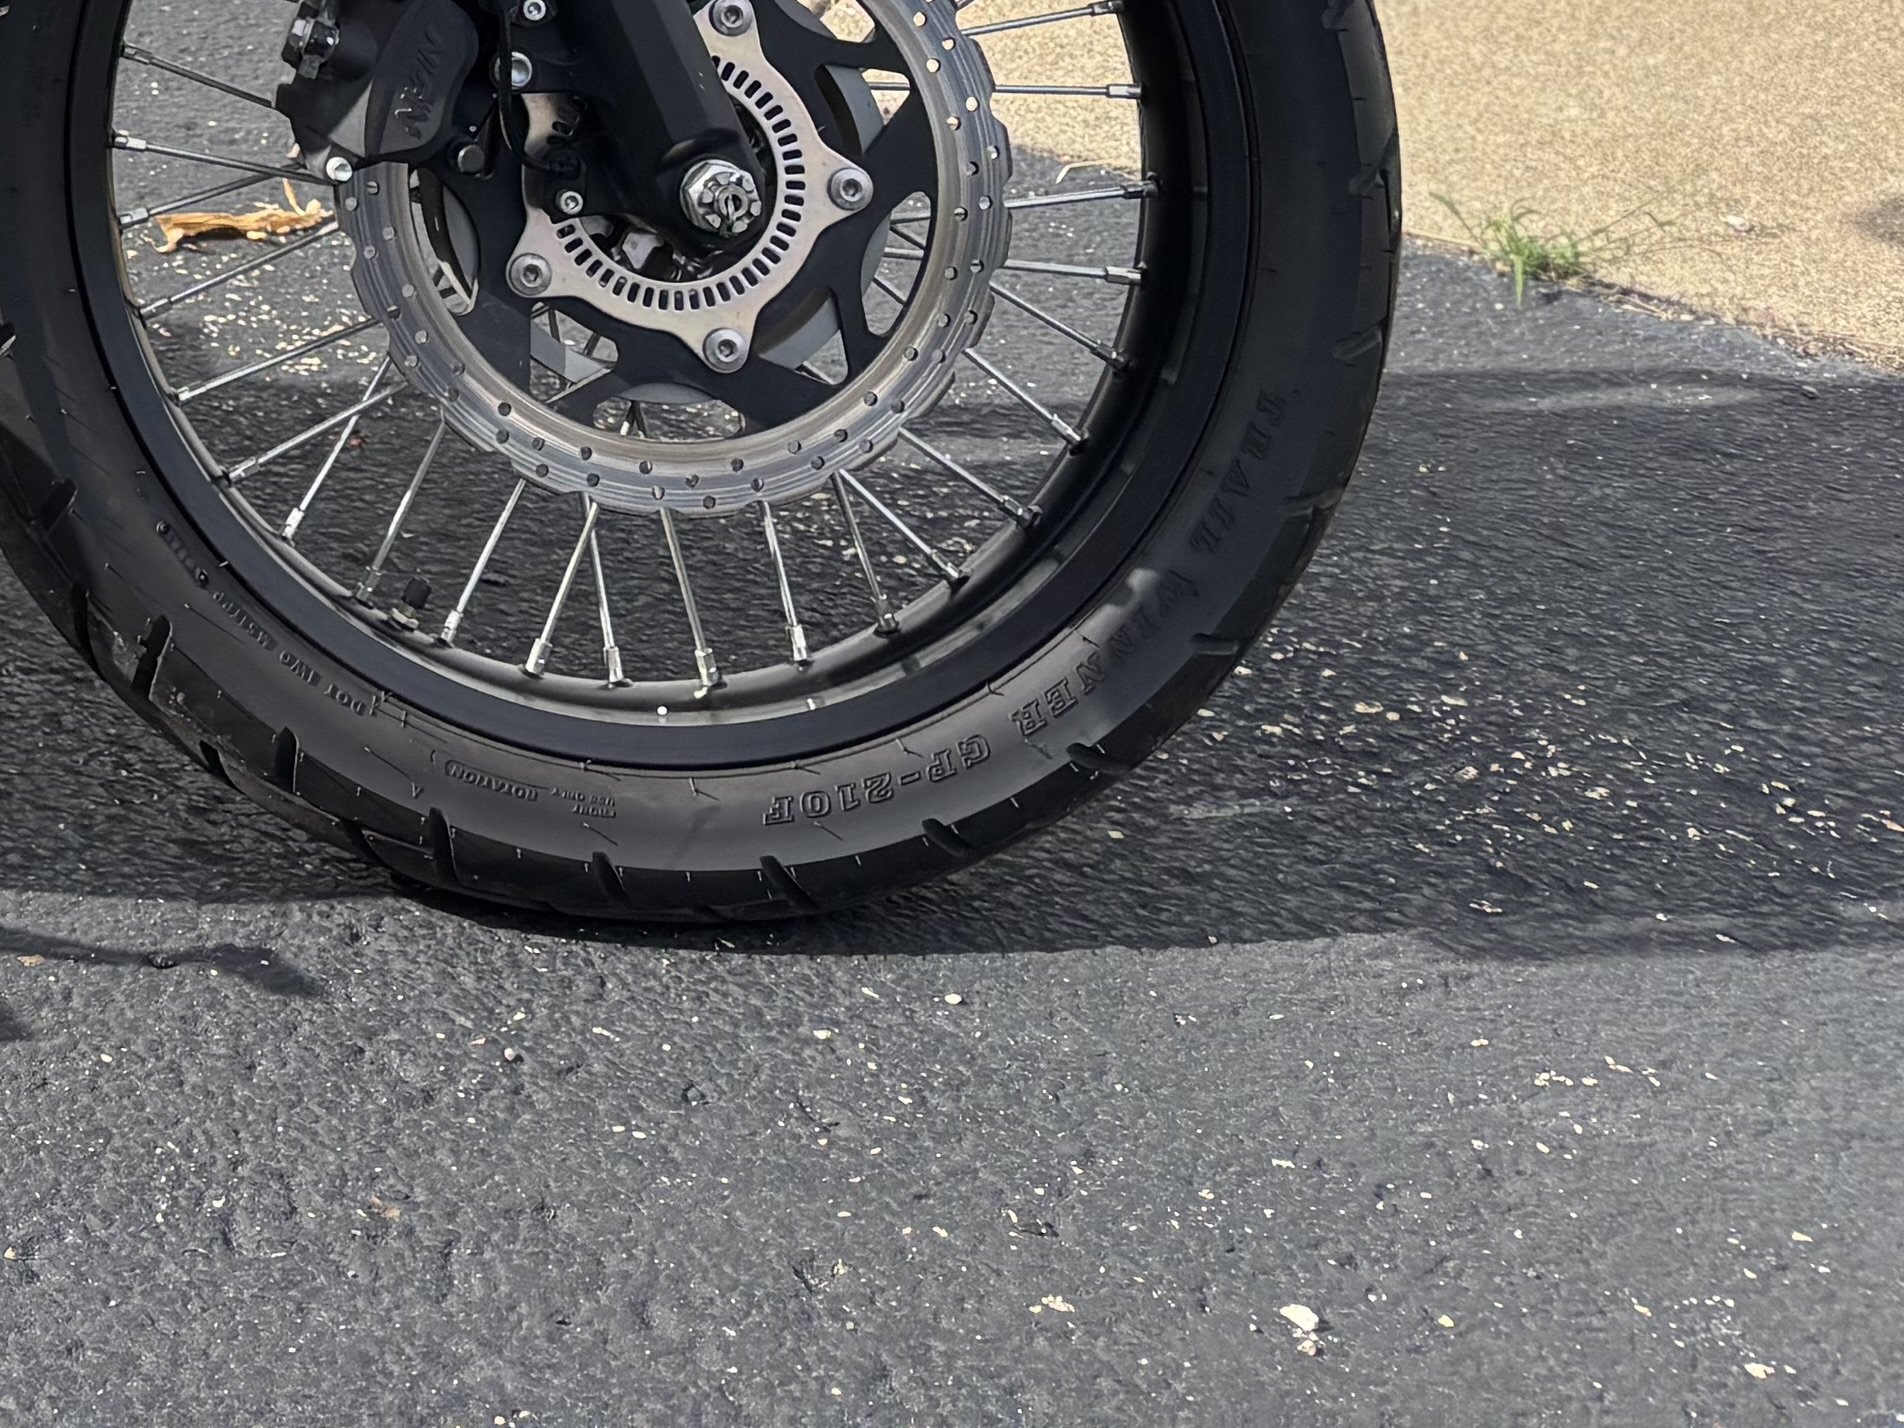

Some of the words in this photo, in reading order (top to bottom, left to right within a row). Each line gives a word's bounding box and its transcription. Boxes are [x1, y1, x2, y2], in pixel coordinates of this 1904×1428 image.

[1188, 393, 1284, 556] TRAIL
[1008, 566, 1195, 739] WINNER
[760, 732, 992, 826] GP-210F
